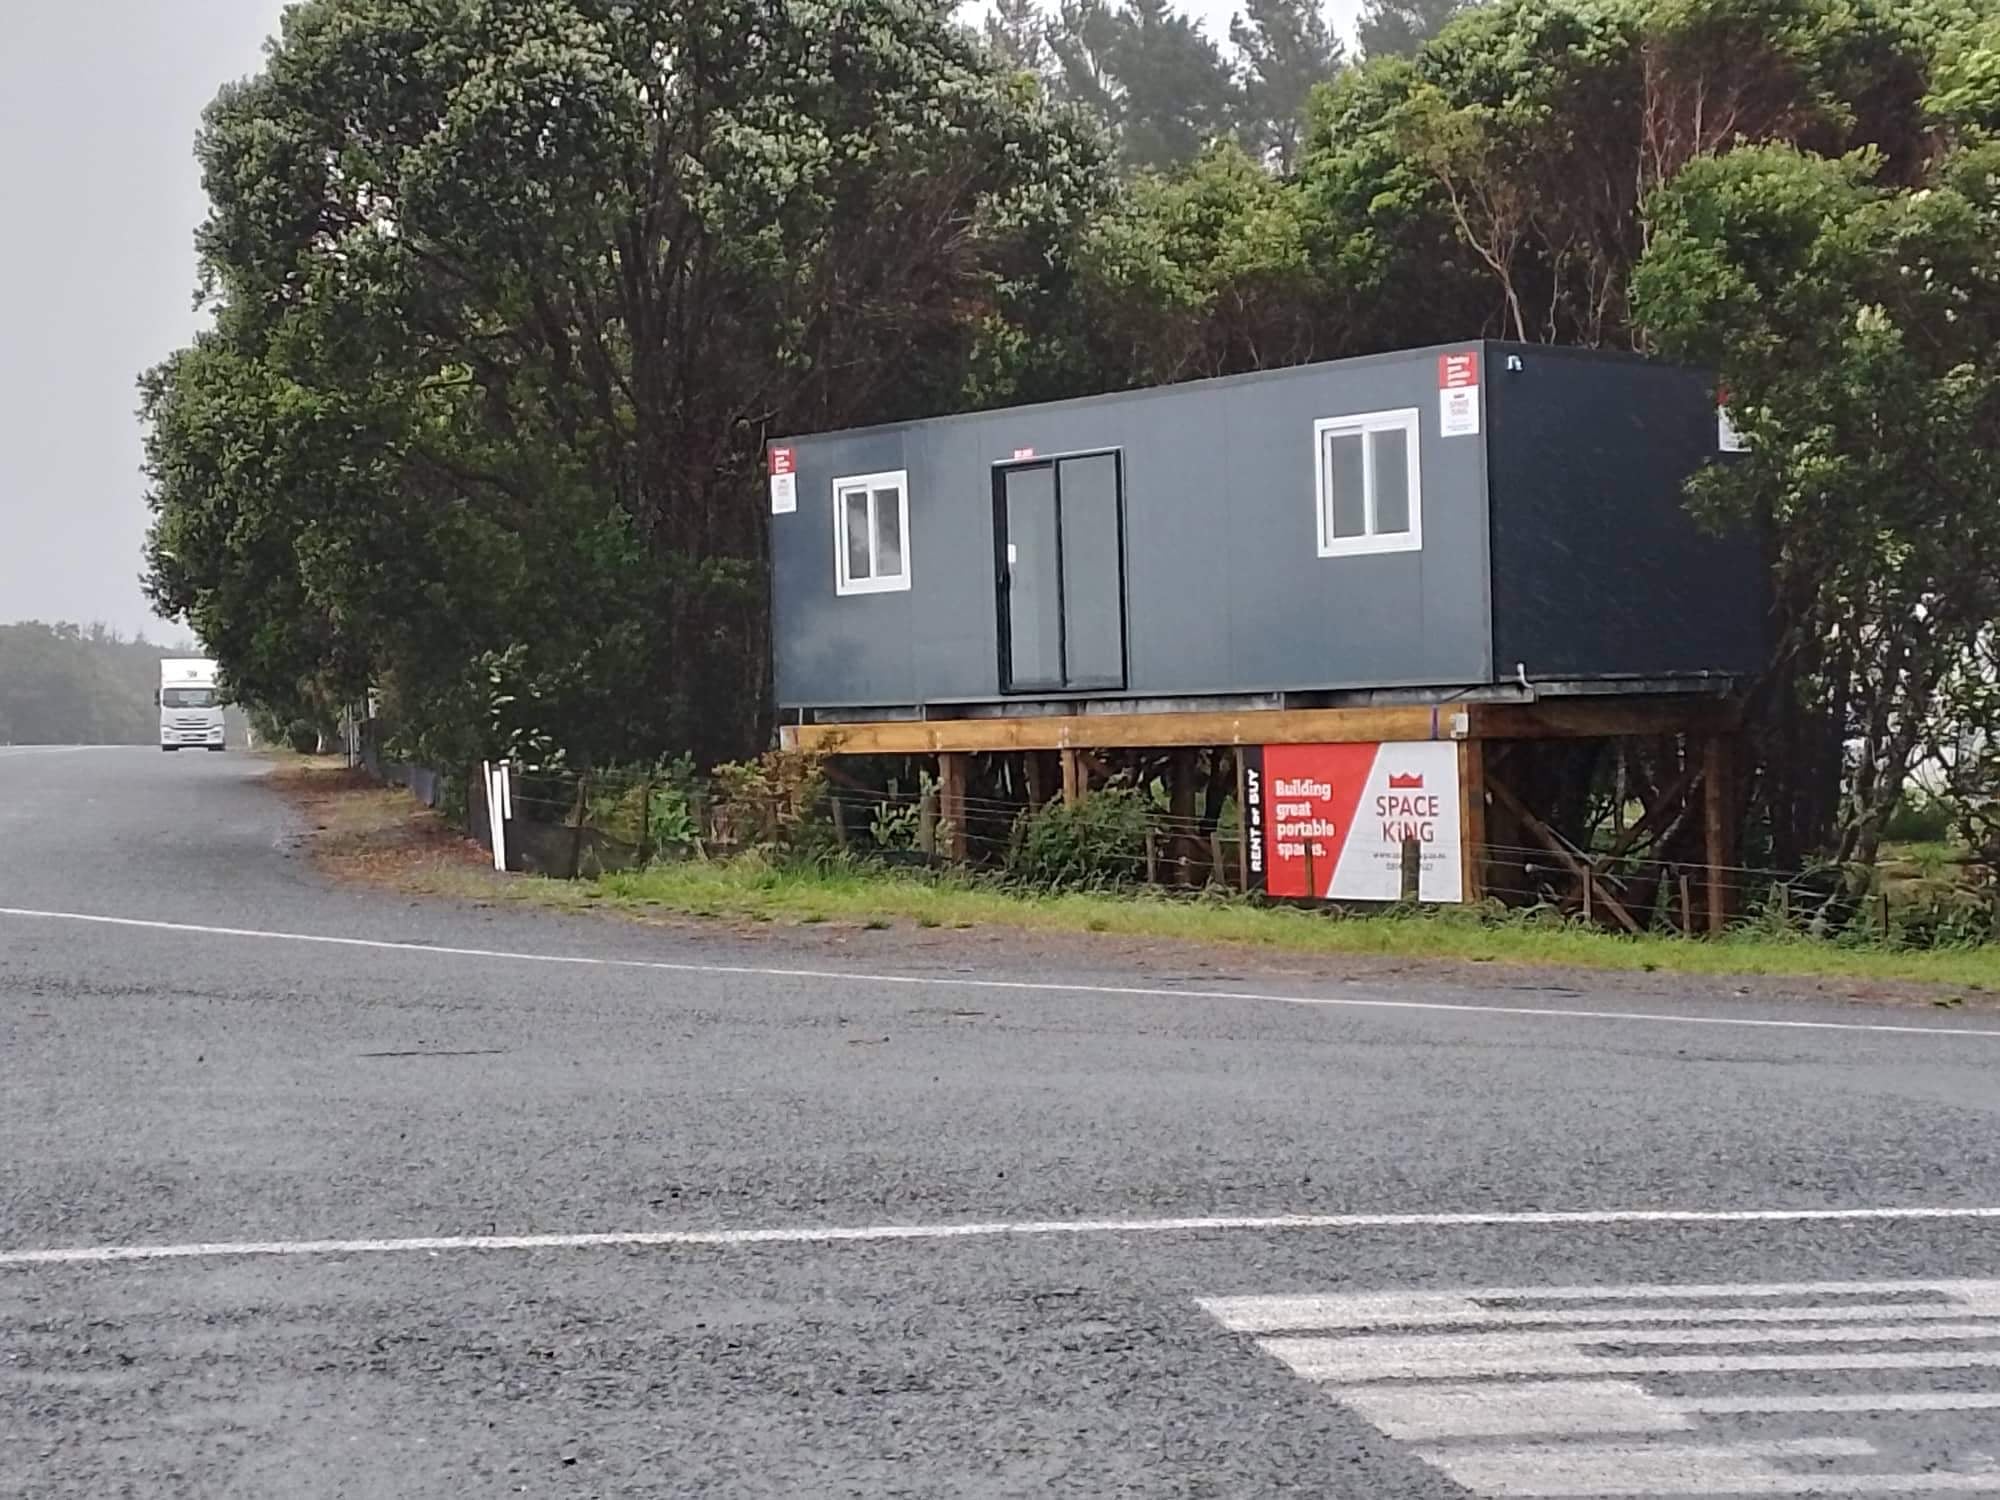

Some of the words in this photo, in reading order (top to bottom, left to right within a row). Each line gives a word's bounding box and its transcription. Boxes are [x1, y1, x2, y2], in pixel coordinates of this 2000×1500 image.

[1248, 769, 1259, 804] BUY
[1275, 779, 1331, 800] Building
[1251, 808, 1260, 825] or
[1276, 801, 1312, 820] great
[1376, 796, 1439, 817] SPACE
[1277, 819, 1335, 840] portable
[1250, 827, 1261, 872] RENT
